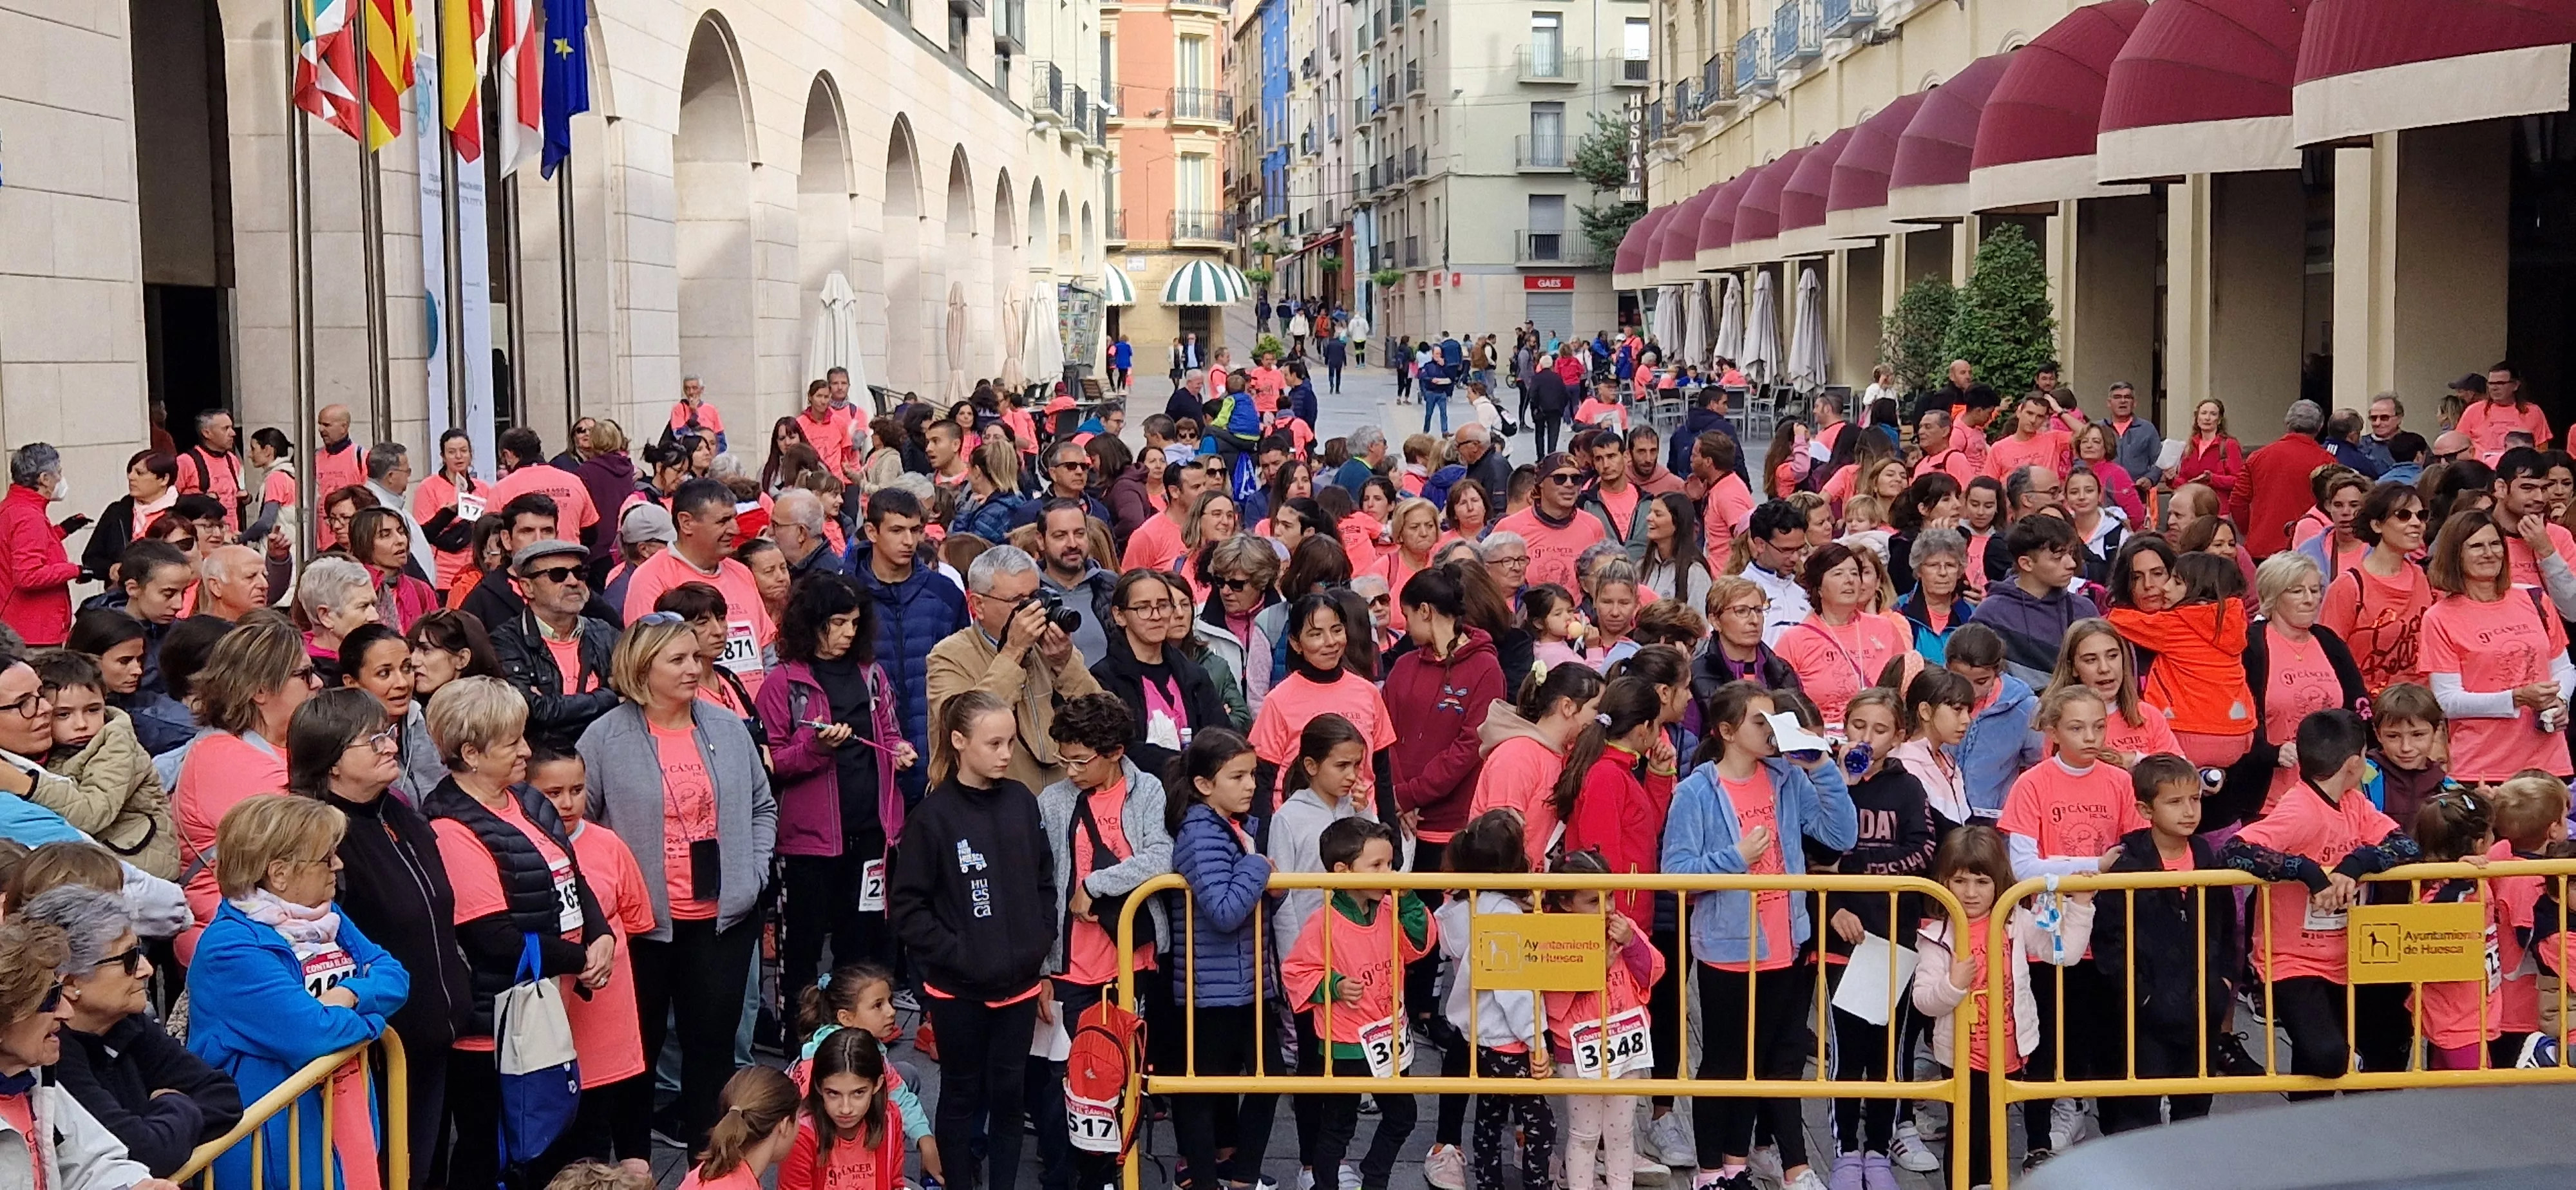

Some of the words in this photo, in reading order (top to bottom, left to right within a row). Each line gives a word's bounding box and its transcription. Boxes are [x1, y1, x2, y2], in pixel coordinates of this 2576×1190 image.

[1628, 93, 1642, 184] HOSTAL
[1538, 279, 1562, 287] GAES
[714, 639, 754, 661] 871
[2067, 802, 2107, 813] CÁNCER
[2403, 929, 2482, 941] Ayuntamiento
[1523, 939, 1600, 952] Ayuntamiento
[2403, 945, 2418, 954] de
[2421, 945, 2464, 954] Huesca
[1524, 952, 1538, 963] de
[1540, 954, 1584, 963] Huesca
